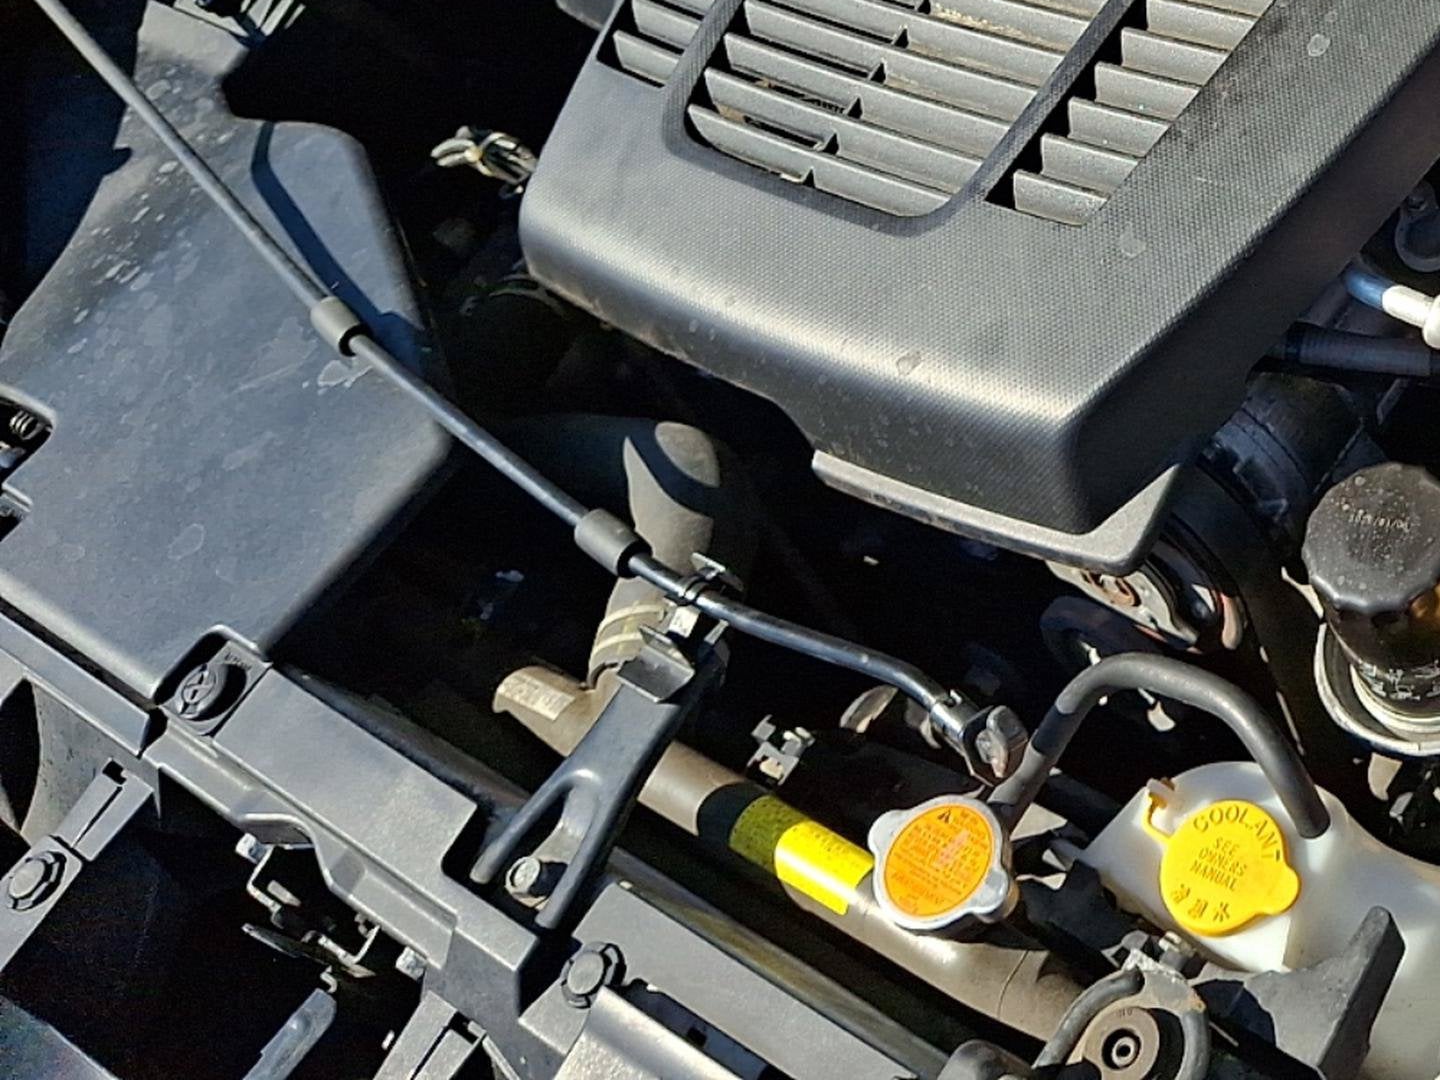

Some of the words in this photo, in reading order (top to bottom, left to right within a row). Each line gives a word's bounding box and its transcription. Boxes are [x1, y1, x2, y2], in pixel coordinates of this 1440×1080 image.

[1193, 804, 1280, 862] COOLANT
[1213, 837, 1240, 856] SEE
[1190, 859, 1238, 892] MANUAL
